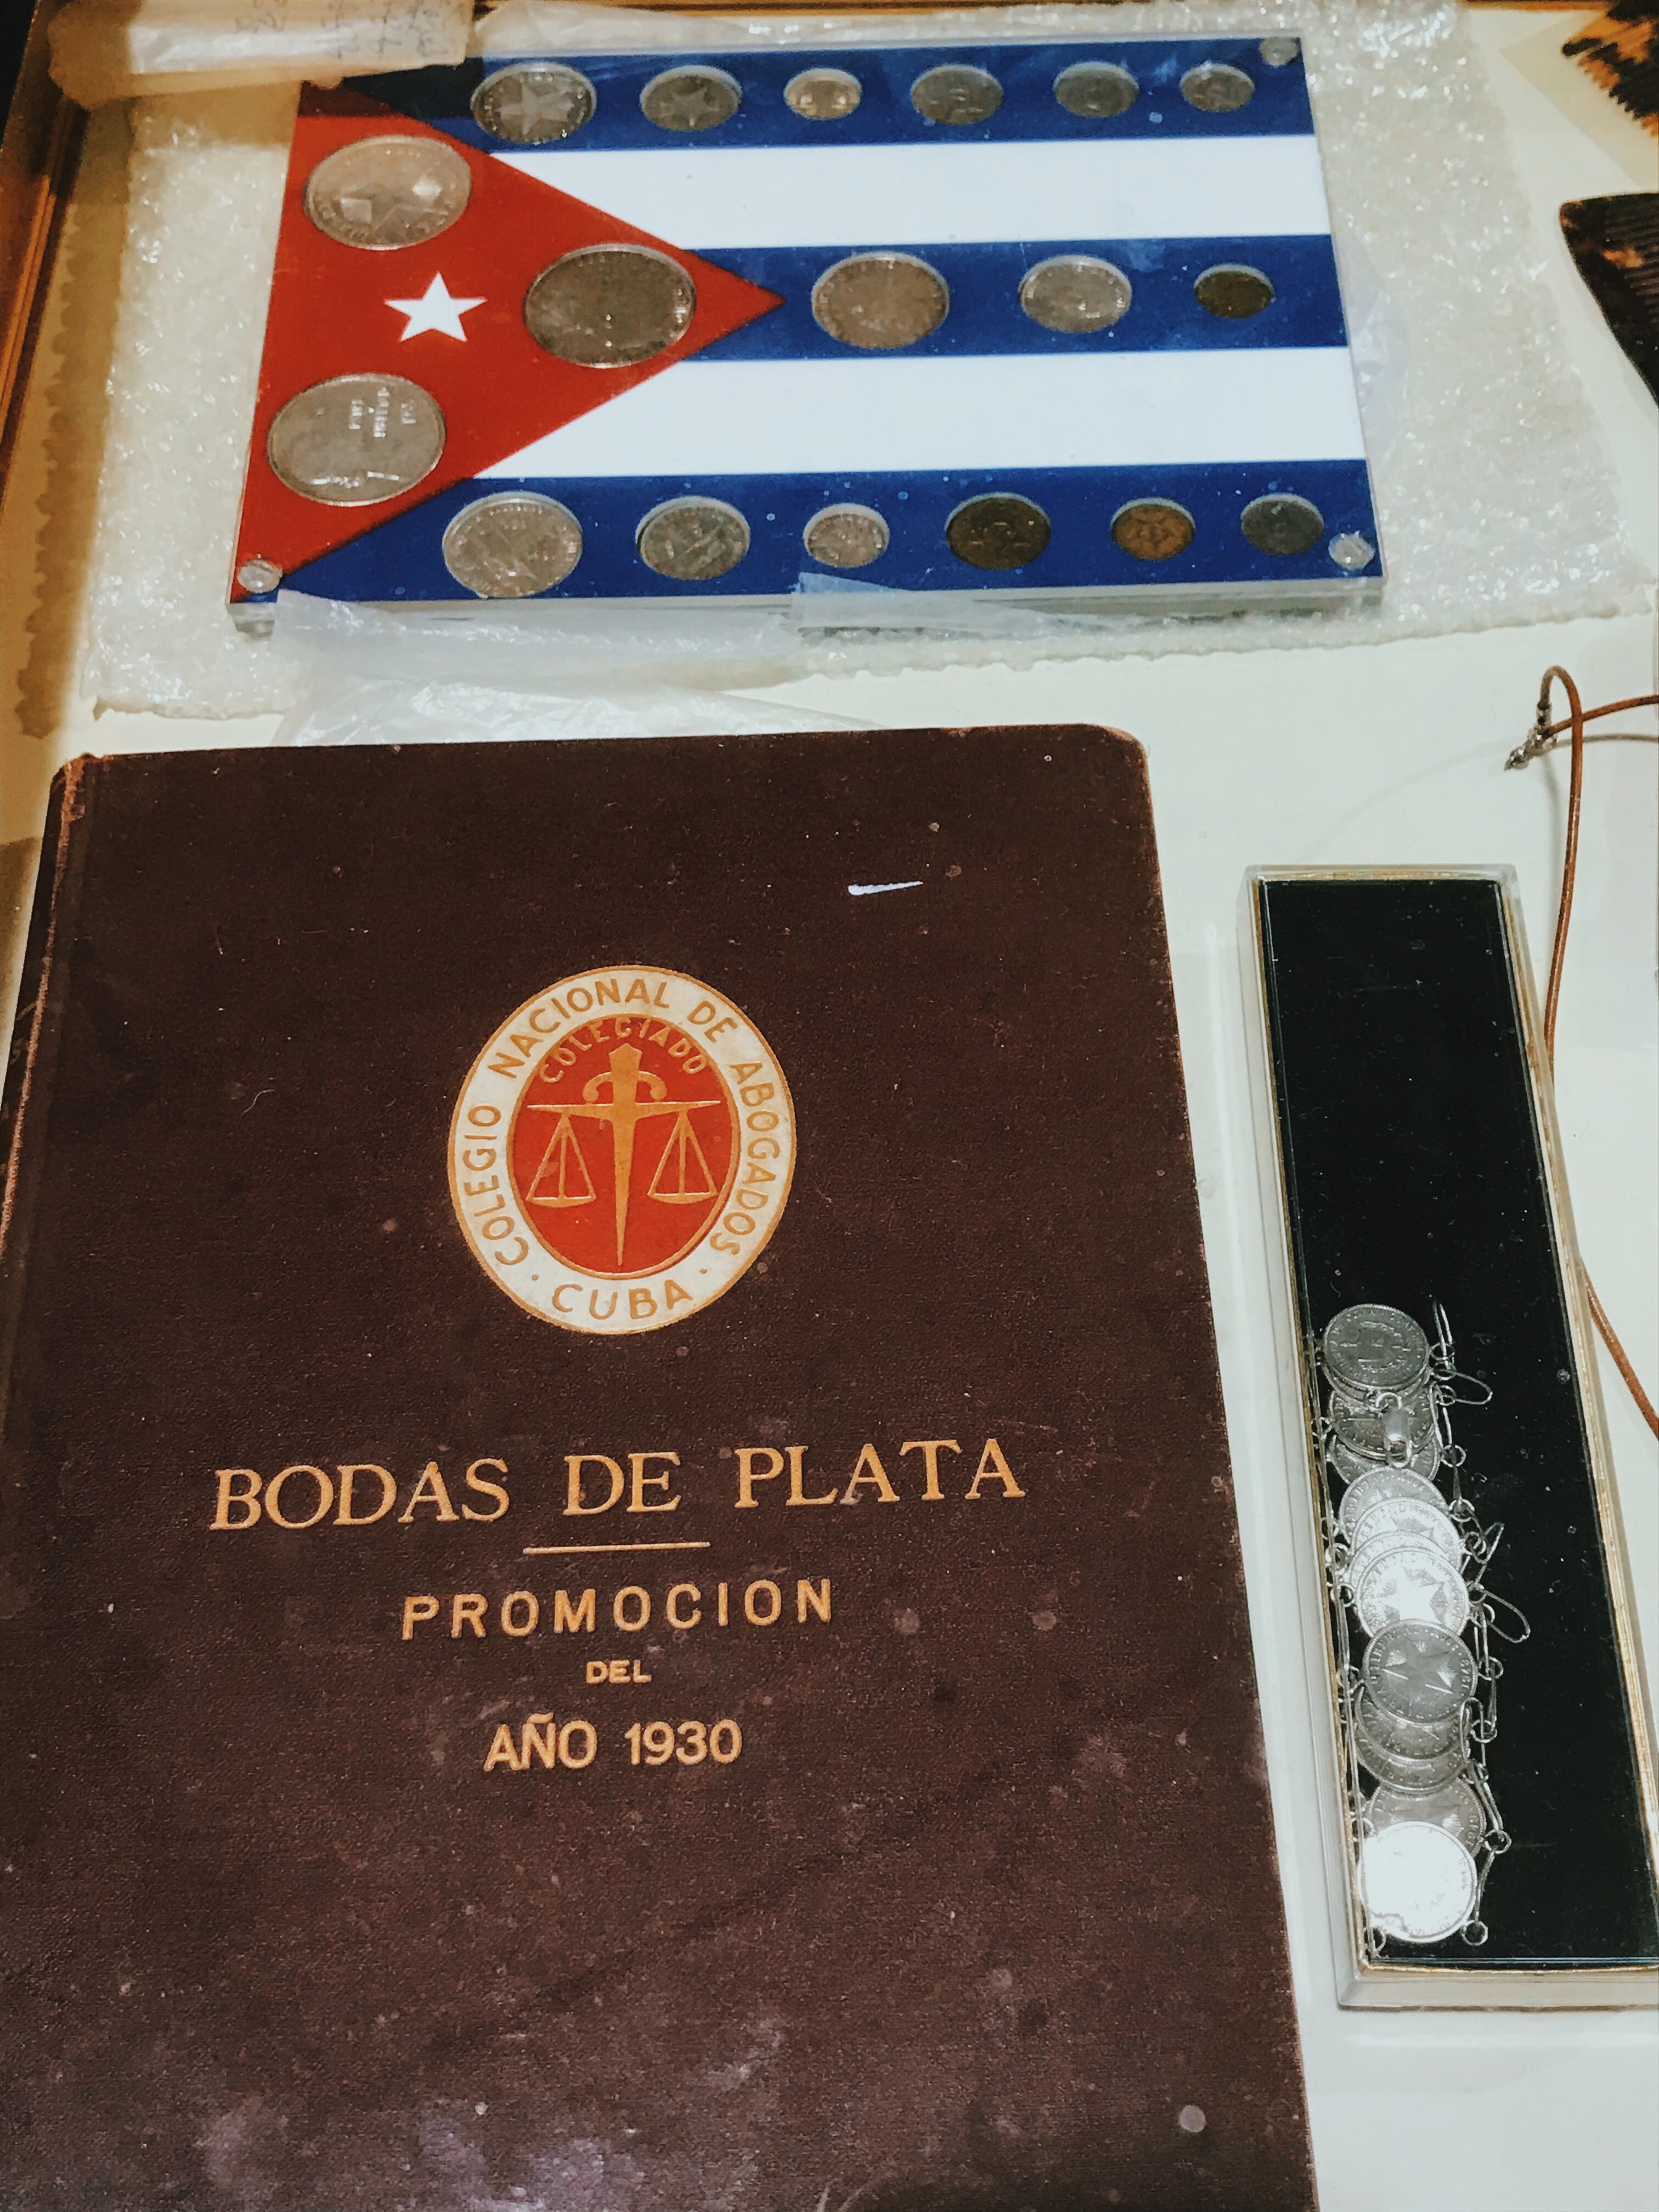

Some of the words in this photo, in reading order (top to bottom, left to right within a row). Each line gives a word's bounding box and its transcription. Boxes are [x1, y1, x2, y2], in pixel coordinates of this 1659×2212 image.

[488, 978, 669, 1078] NACIONAL
[540, 1018, 708, 1084] COLEGIADO
[687, 1000, 737, 1043] DE
[463, 1105, 529, 1265] COLEGIO
[710, 1062, 780, 1255] ABOGADOS
[551, 1279, 692, 1319] CUBA
[210, 1459, 509, 1530] BODAS
[563, 1452, 680, 1515] DE
[735, 1439, 1025, 1508] PLATA
[403, 1579, 831, 1639] PROMOCION
[586, 1660, 651, 1683] DEL
[484, 1713, 597, 1771] AÑO
[625, 1719, 742, 1765] 1930
